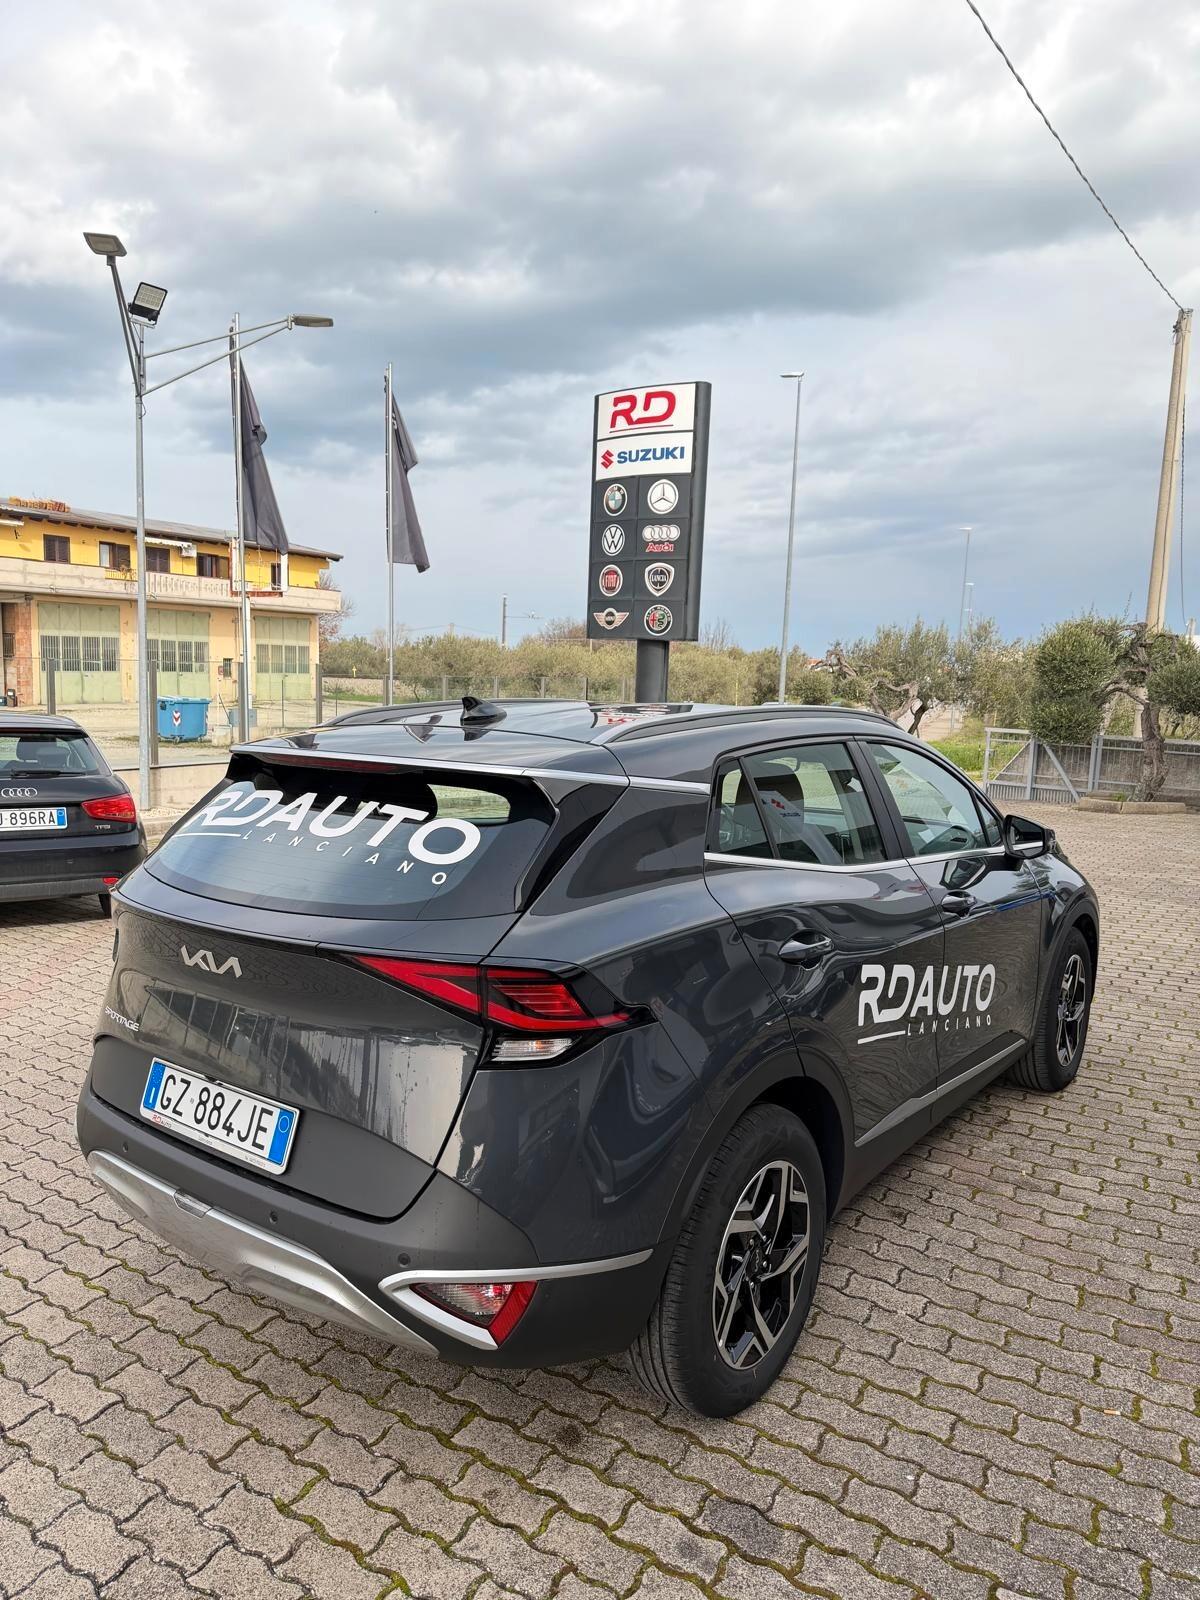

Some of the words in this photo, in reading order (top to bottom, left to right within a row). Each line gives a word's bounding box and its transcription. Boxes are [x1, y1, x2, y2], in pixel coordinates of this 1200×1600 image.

[610, 390, 676, 428] RD
[617, 446, 685, 464] SUZUKI
[645, 542, 674, 552] Audi
[9, 811, 56, 825] 896RA
[242, 830, 447, 885] LANCIANO
[105, 1005, 140, 1032] SPORTAGE
[908, 1014, 992, 1036] LANCIANO
